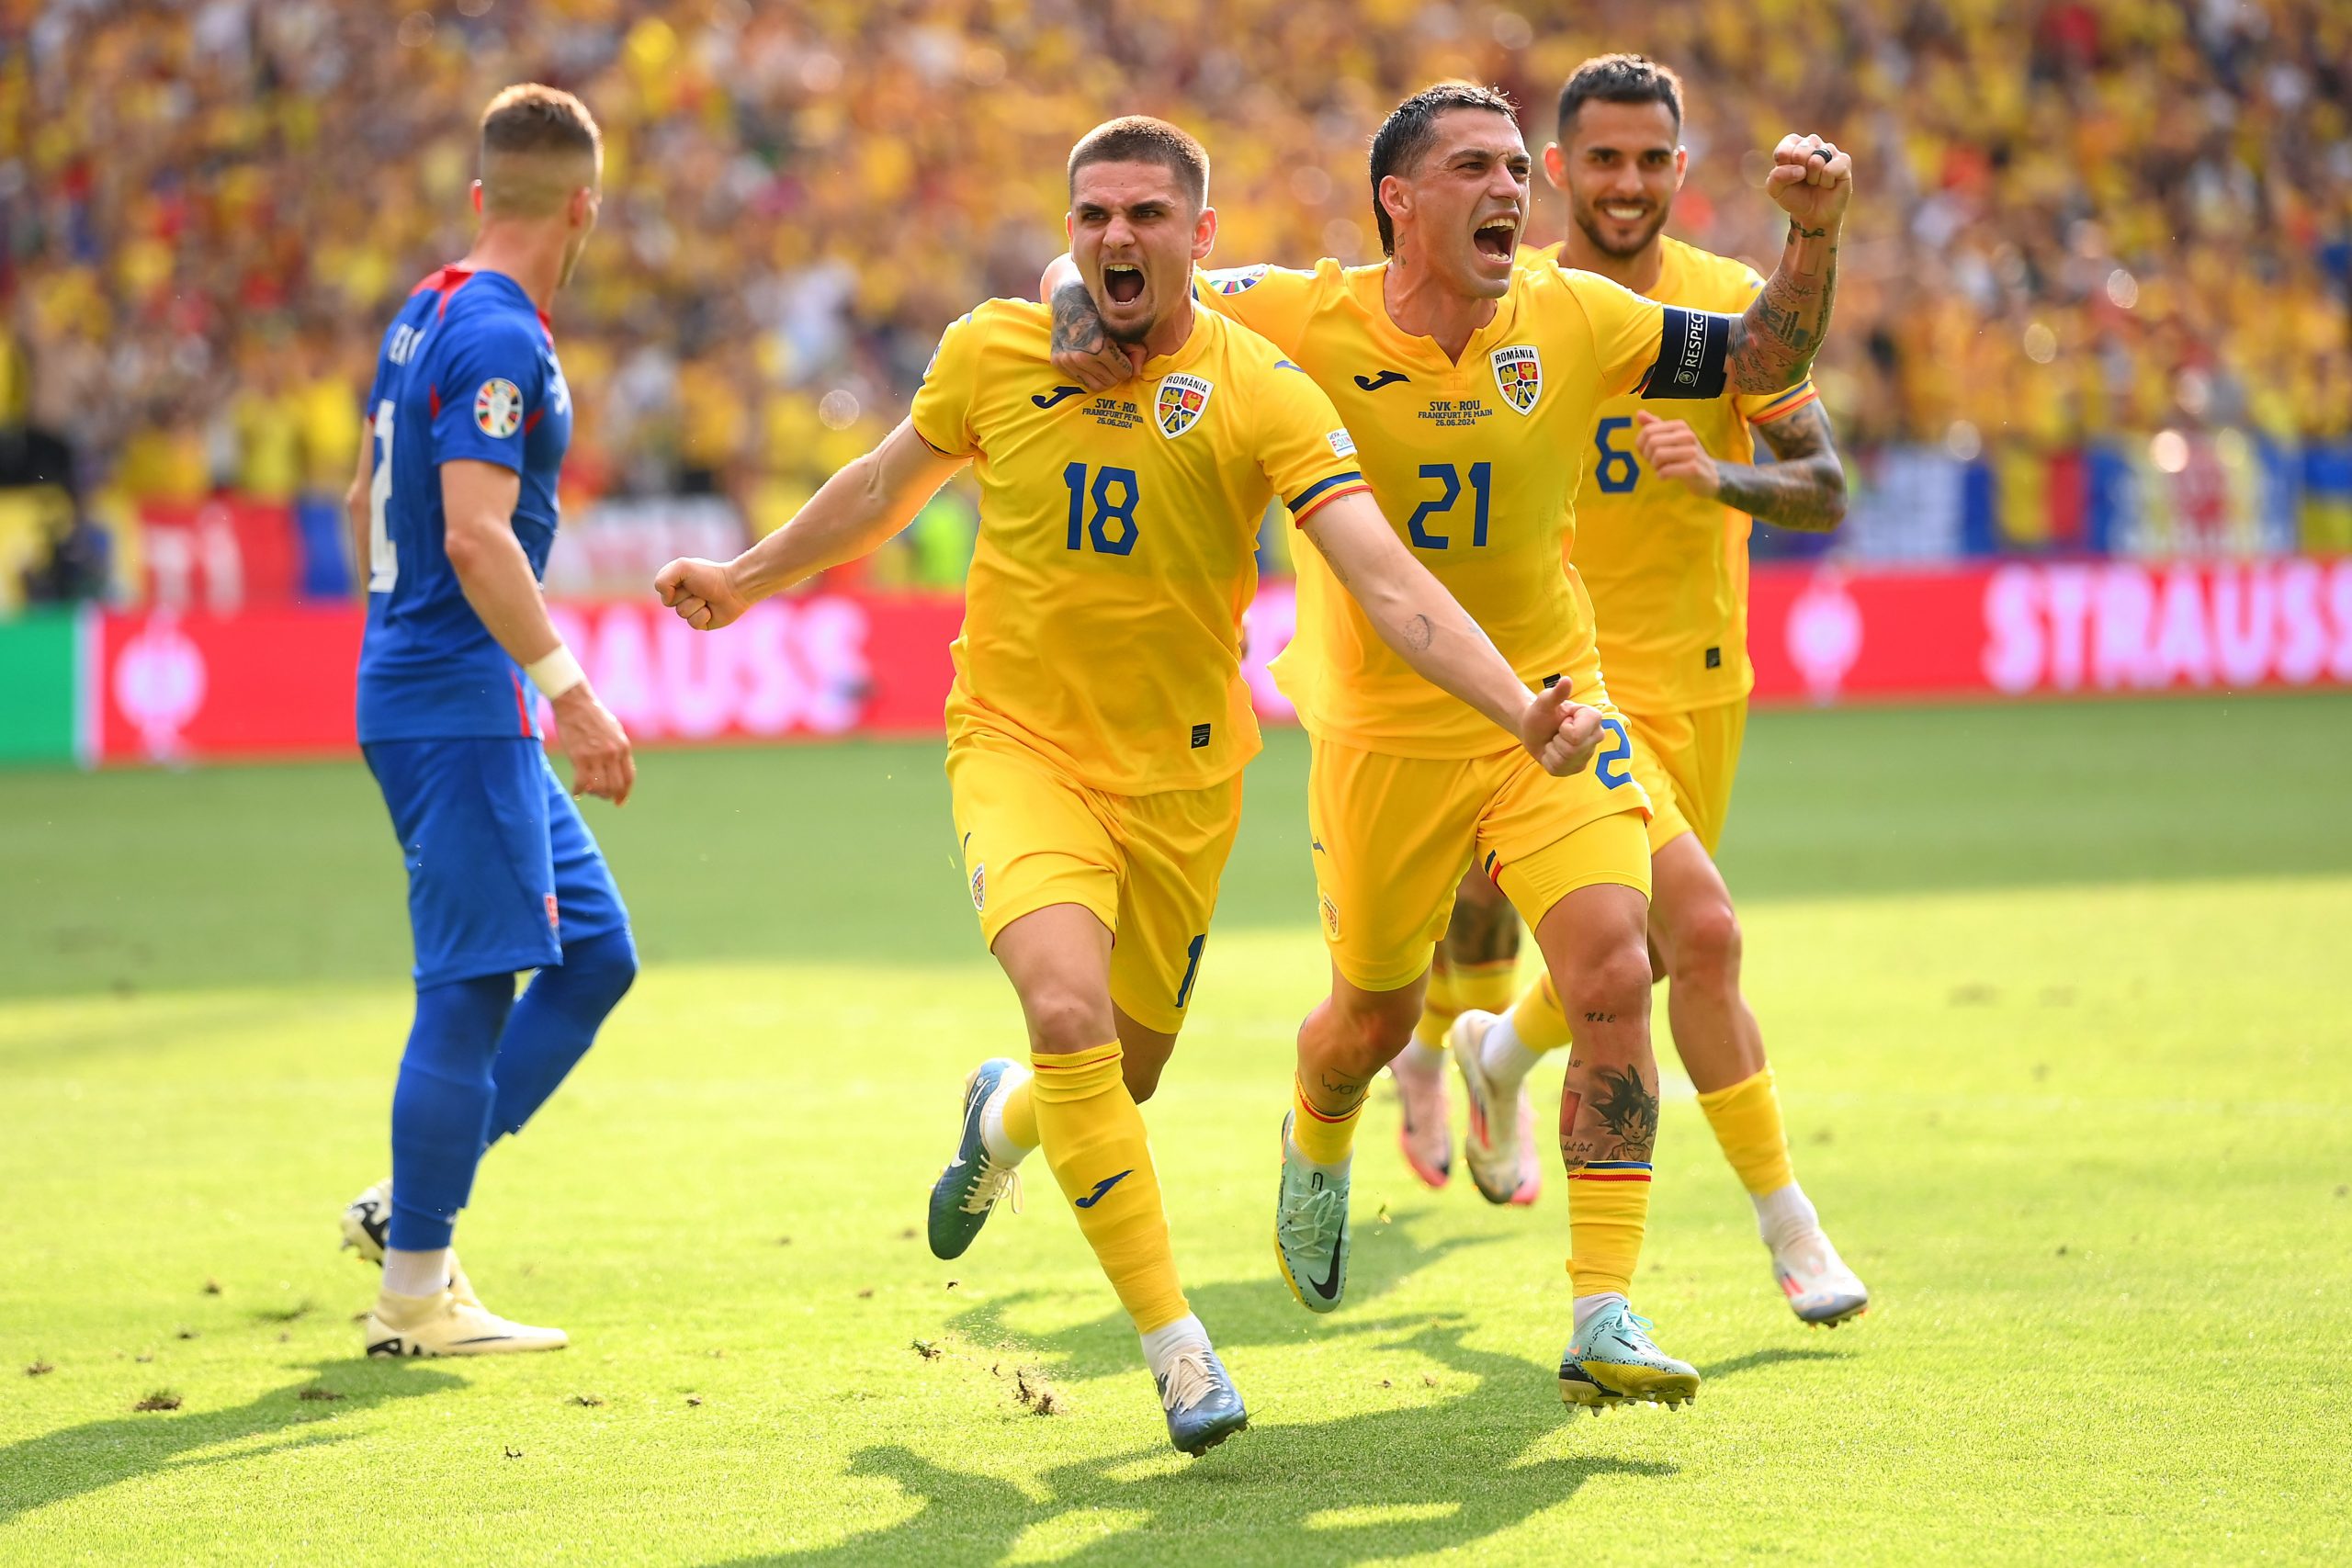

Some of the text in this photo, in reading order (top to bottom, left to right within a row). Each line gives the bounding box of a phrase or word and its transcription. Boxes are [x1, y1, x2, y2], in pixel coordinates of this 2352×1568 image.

[1495, 347, 1535, 365] ROMÂNIA
[1684, 310, 1705, 367] RESPEC
[1166, 376, 1208, 393] ROMÂNIA
[1082, 408, 1125, 420] FRANKFURT
[1095, 398, 1116, 410] SVK
[1418, 411, 1462, 419] FRANKFURT
[1474, 409, 1493, 418] MAIN
[1430, 401, 1451, 412] SVK
[1459, 400, 1480, 411] ROU
[1096, 417, 1133, 429] 26.06.2024
[1595, 417, 1640, 494] 6
[1063, 461, 1139, 557] 18
[1407, 462, 1491, 549] 21
[548, 599, 876, 740] AUSS
[1595, 719, 1633, 790] 2
[1175, 933, 1206, 1008] 1
